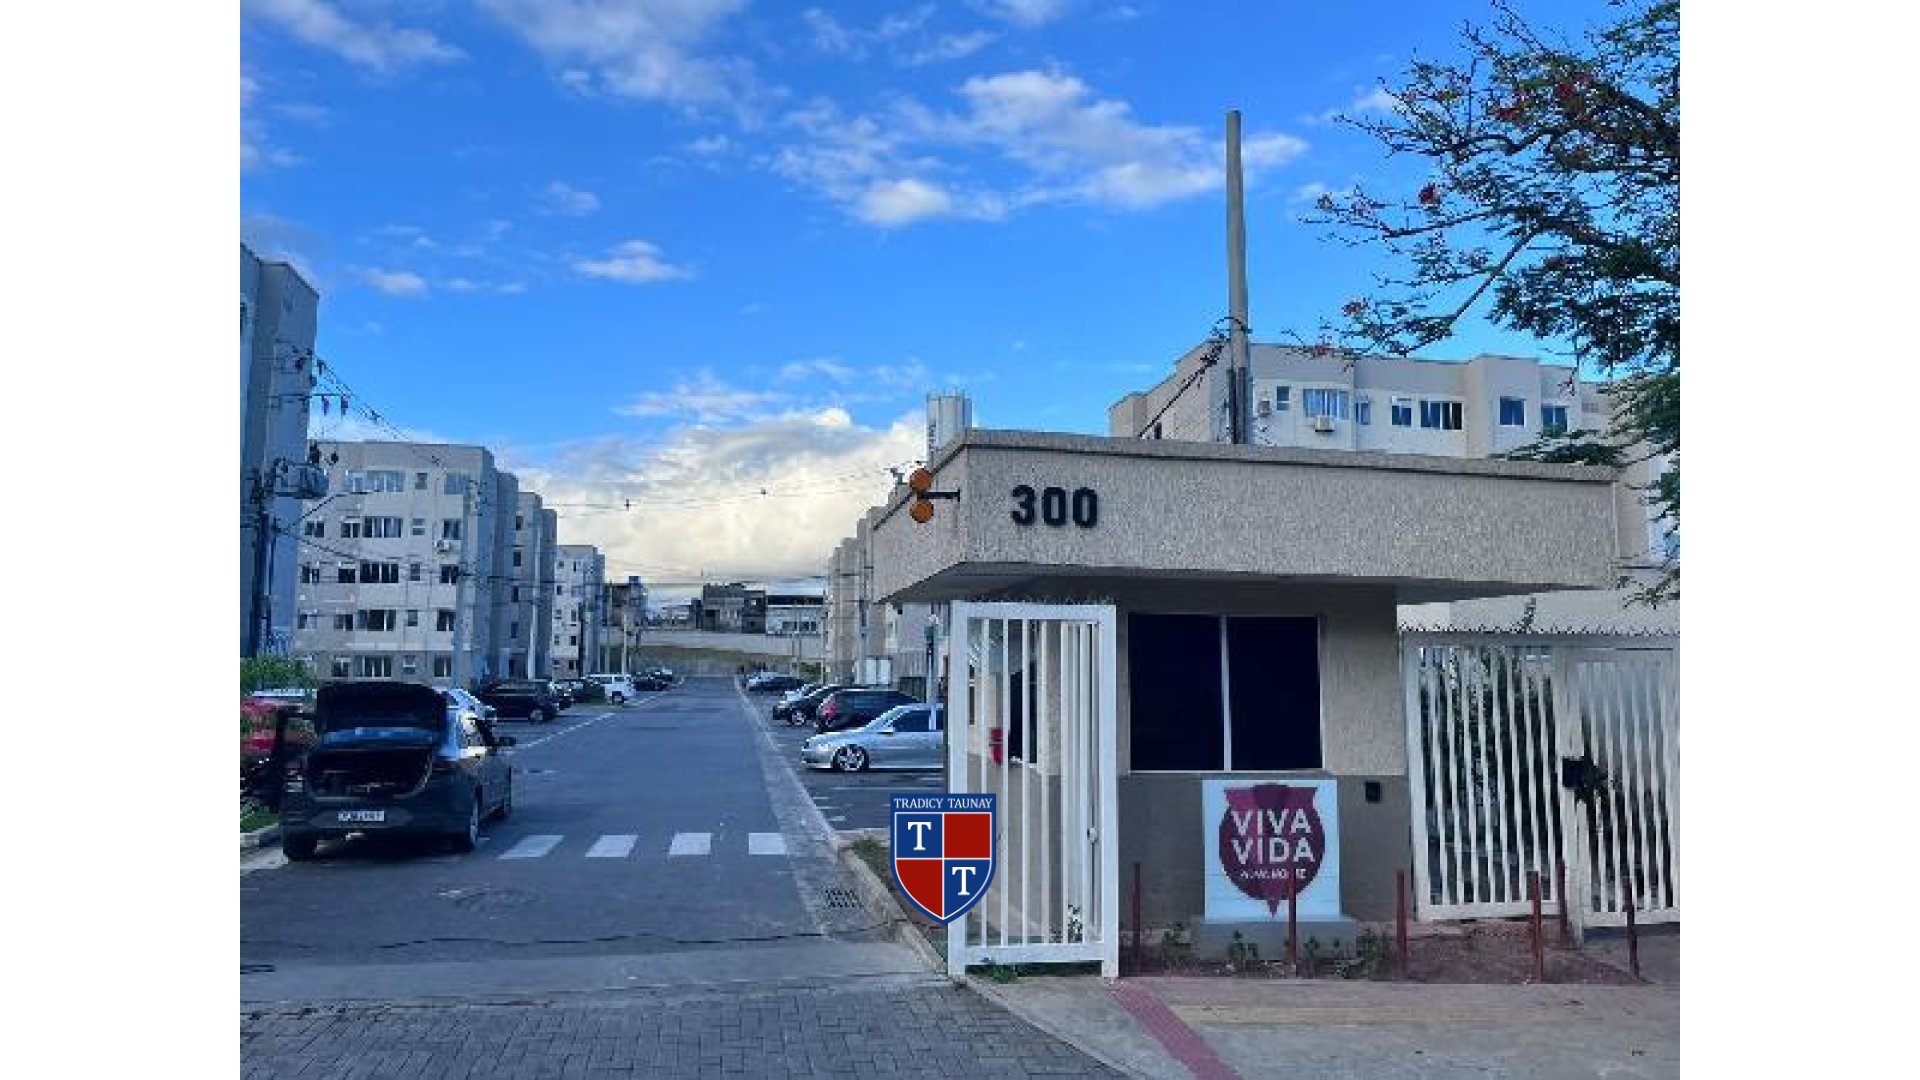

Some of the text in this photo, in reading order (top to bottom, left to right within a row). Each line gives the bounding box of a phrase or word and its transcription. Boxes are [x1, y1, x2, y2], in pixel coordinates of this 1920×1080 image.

[1011, 484, 1098, 528] 300
[1231, 808, 1311, 835] VIVA
[1231, 838, 1315, 864] VIDA
